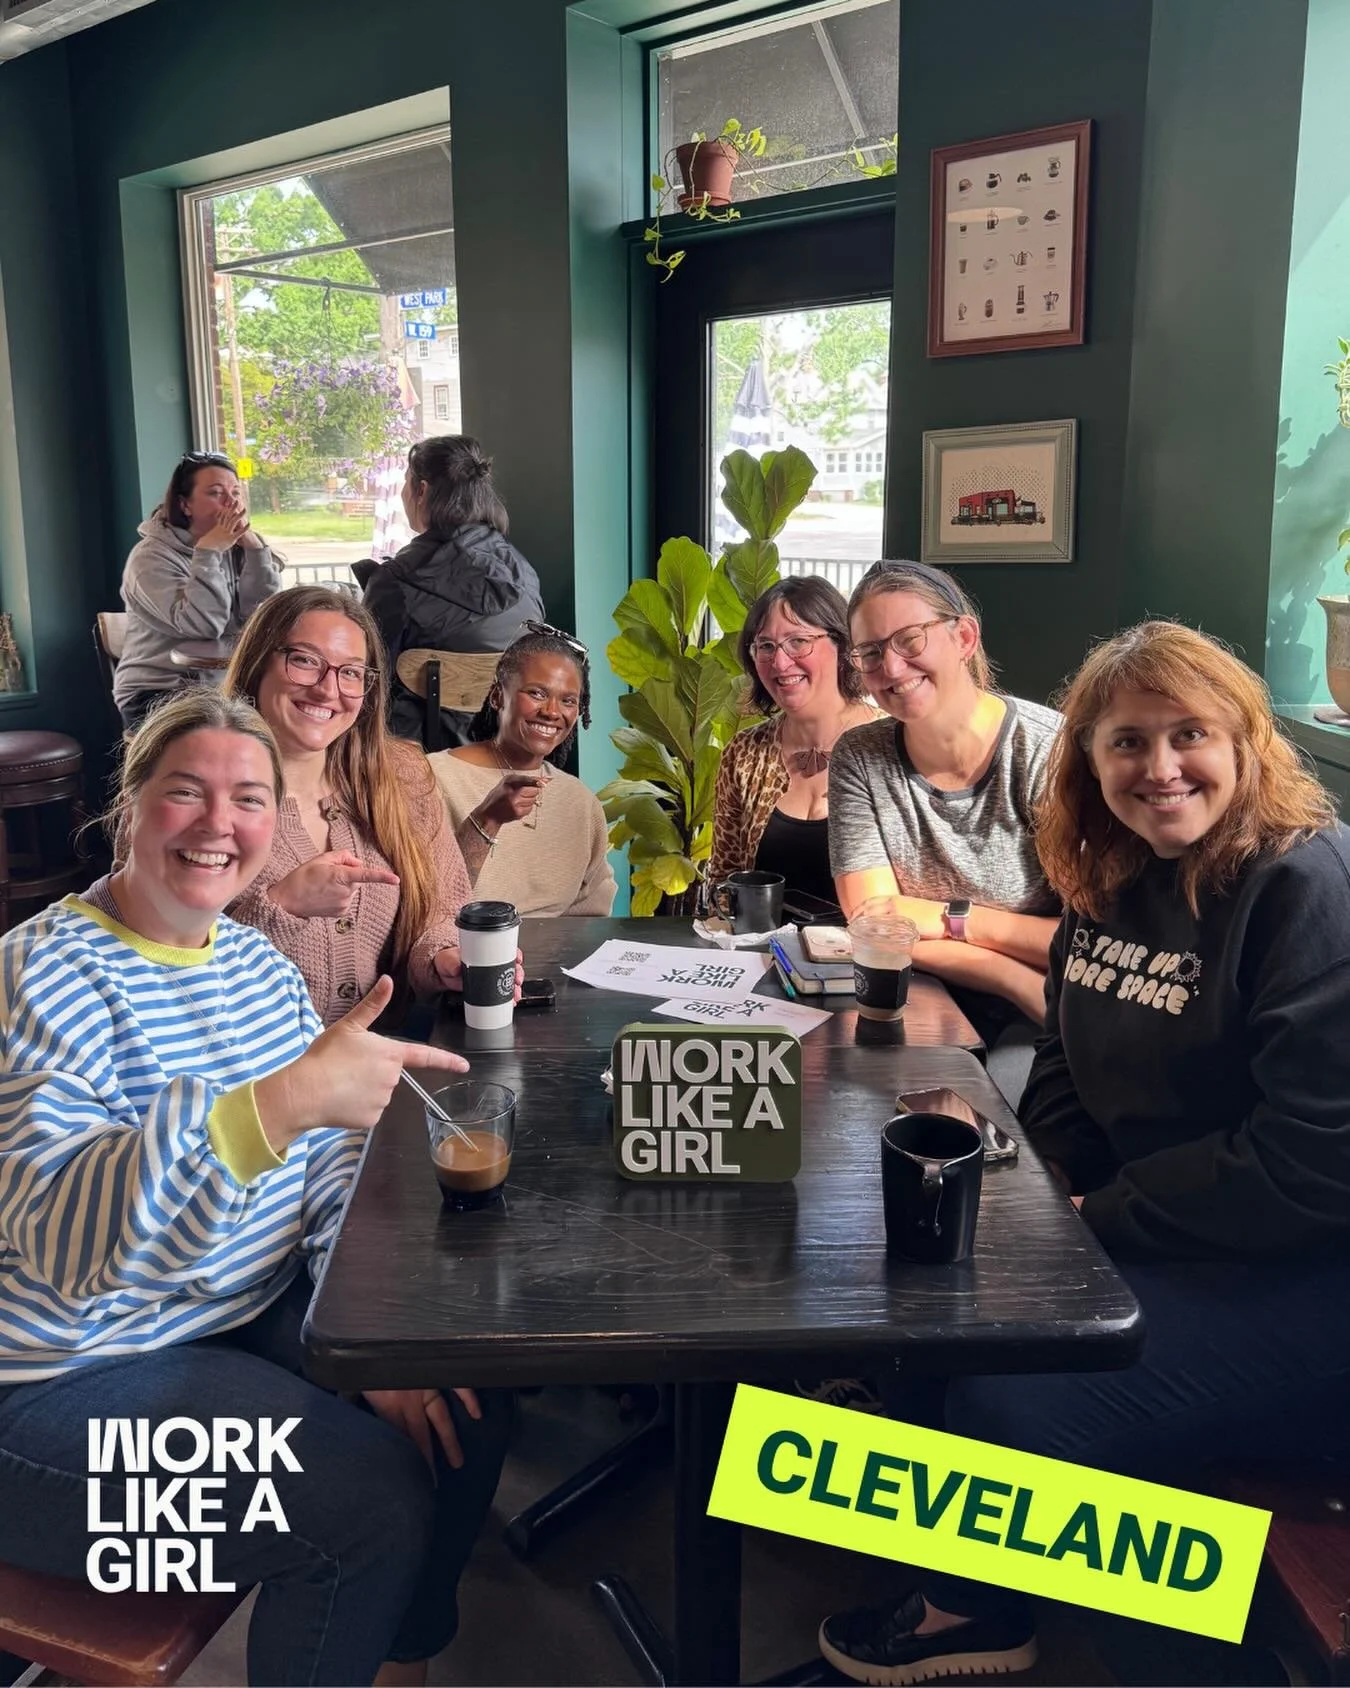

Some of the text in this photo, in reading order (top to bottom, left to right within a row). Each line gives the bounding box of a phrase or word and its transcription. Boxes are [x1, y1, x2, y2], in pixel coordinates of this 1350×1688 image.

[696, 963, 746, 975] GIRL
[1092, 935, 1182, 978] TAKE UP
[656, 974, 736, 988] WORK
[672, 968, 741, 982] LIKE A
[1116, 973, 1190, 1016] SPACE
[683, 1003, 725, 1019] GIRL
[736, 1008, 754, 1017] A
[621, 1038, 796, 1085] WORK
[621, 1084, 785, 1130] LIKE A
[621, 1130, 741, 1174] GIRL
